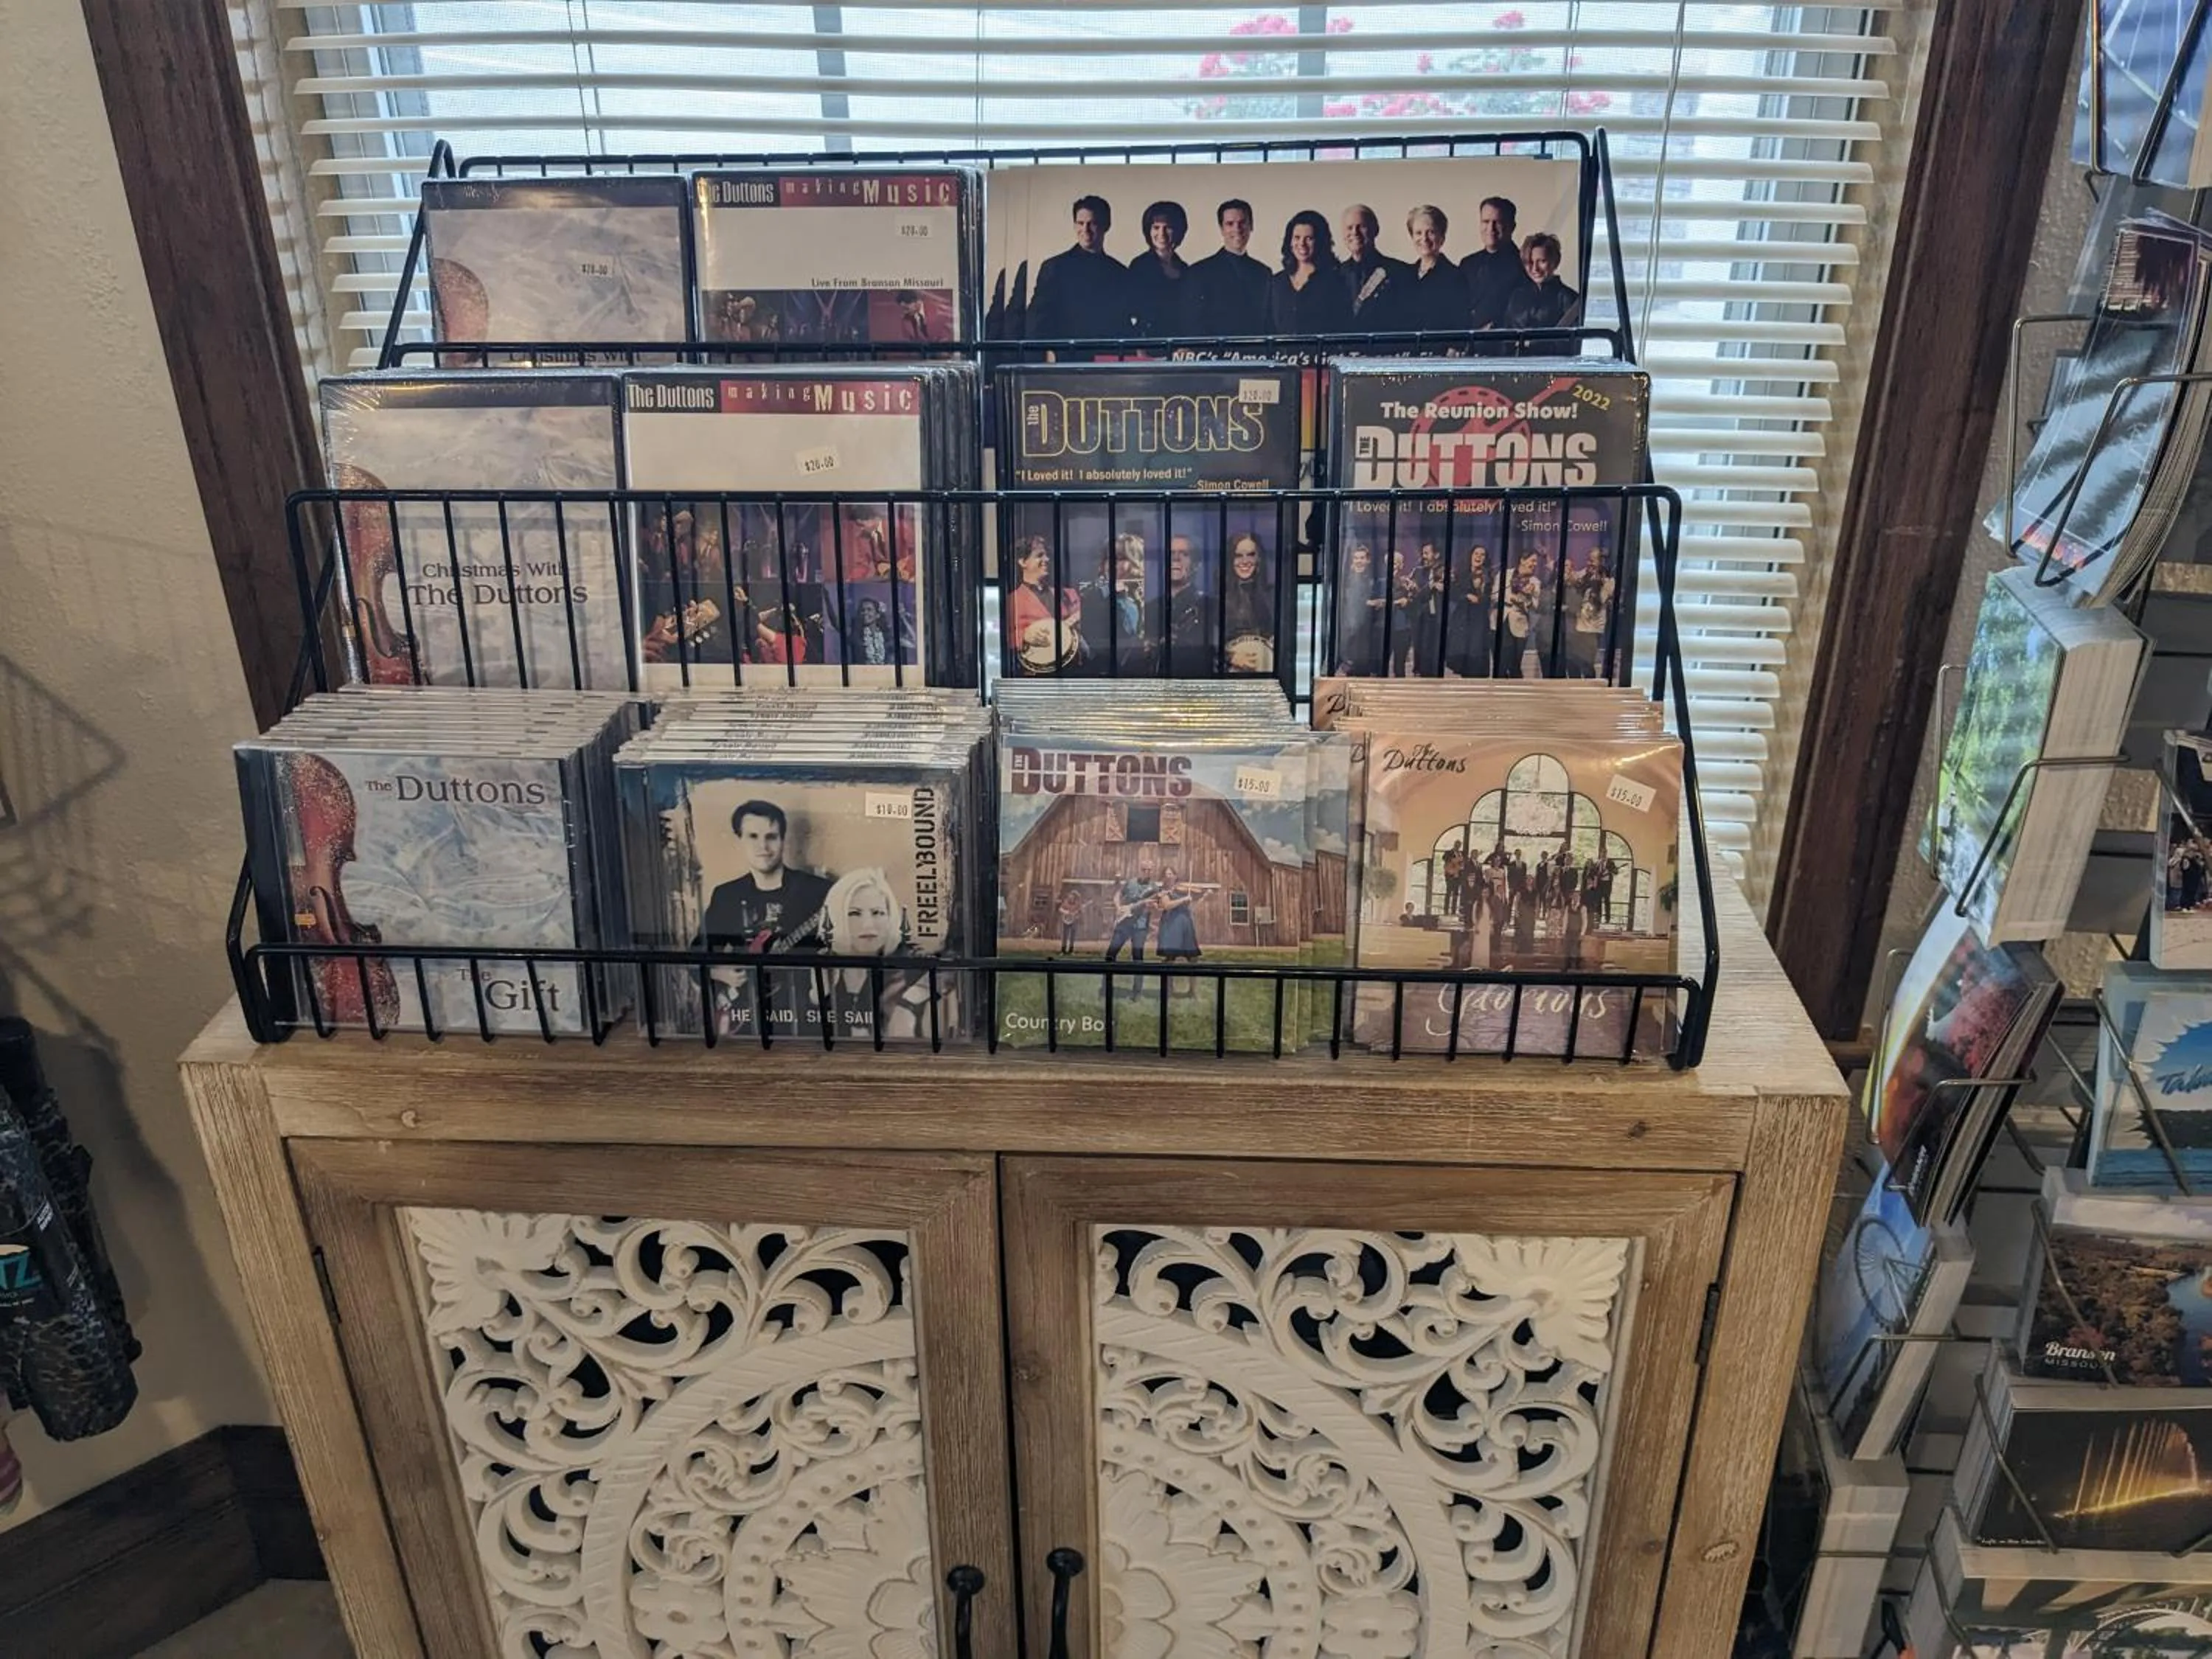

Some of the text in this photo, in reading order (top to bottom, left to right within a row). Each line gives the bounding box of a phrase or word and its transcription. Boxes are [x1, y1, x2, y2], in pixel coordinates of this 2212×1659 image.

[723, 181, 774, 204] Duttons
[785, 177, 860, 196] making
[863, 178, 950, 204] Music
[811, 277, 944, 288] Live From Branson Missouri
[627, 383, 913, 412] The Duttons making Music
[1571, 384, 1612, 411] 2022
[1026, 405, 1039, 425] the
[1380, 402, 1578, 420] The Reunion Show!
[1021, 391, 1265, 457] DUTTONS
[1358, 435, 1371, 455] THE
[1353, 425, 1598, 488] DUTTONS
[1027, 469, 1059, 481] Loved
[1061, 469, 1073, 480] it!
[1085, 468, 1141, 482] absolutely
[1144, 467, 1172, 479] loved
[1498, 500, 1534, 512] lved
[422, 561, 563, 578] Chstmas Wit
[1382, 748, 1468, 773] Duttons
[1011, 747, 1192, 797] DUTTONS
[365, 775, 546, 805] The Duttons
[456, 967, 492, 981] Te
[731, 1009, 751, 1022] HE
[1005, 1012, 1110, 1034] Counry Bo
[2045, 1357, 2101, 1369] MISSOU
